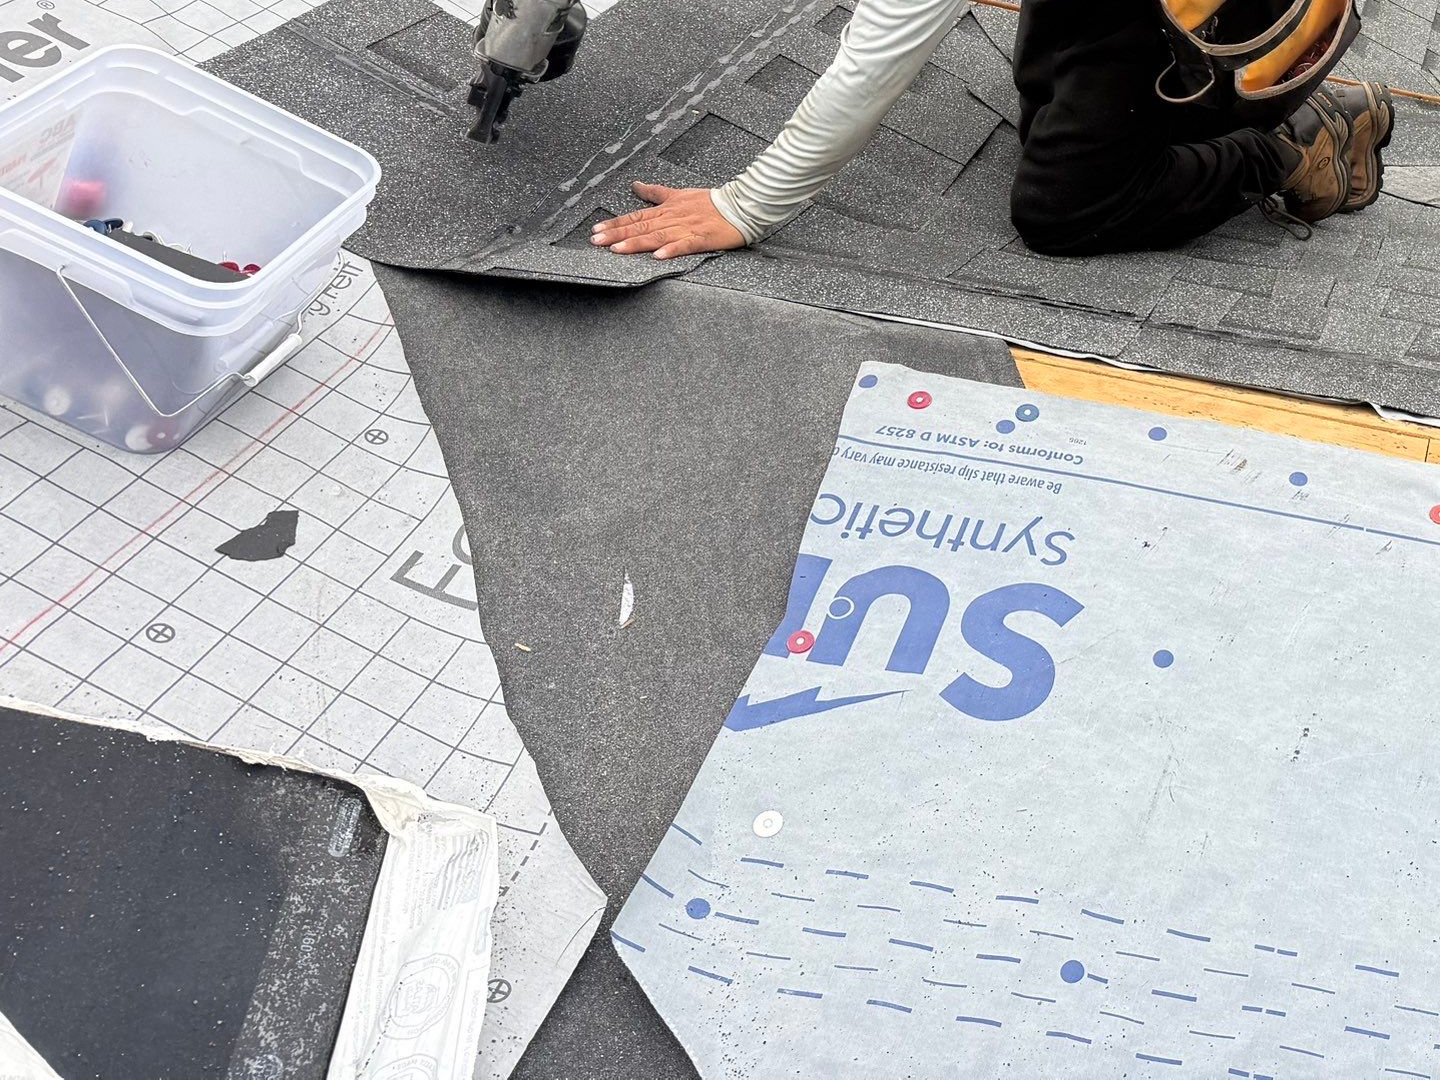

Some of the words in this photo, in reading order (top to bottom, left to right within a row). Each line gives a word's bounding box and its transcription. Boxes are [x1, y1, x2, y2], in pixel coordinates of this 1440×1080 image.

[875, 424, 917, 439] 8257
[919, 431, 932, 442] D
[936, 432, 981, 448] ASTM
[984, 440, 1005, 452] to:
[840, 447, 868, 464] vary
[868, 451, 896, 467] may
[1008, 443, 1084, 465] Conforms
[897, 457, 958, 475] resistance
[957, 464, 980, 481] slip
[979, 470, 1006, 485] that
[1007, 472, 1044, 489] aware
[1046, 480, 1062, 494] Be
[809, 493, 1076, 566] Synthetic
